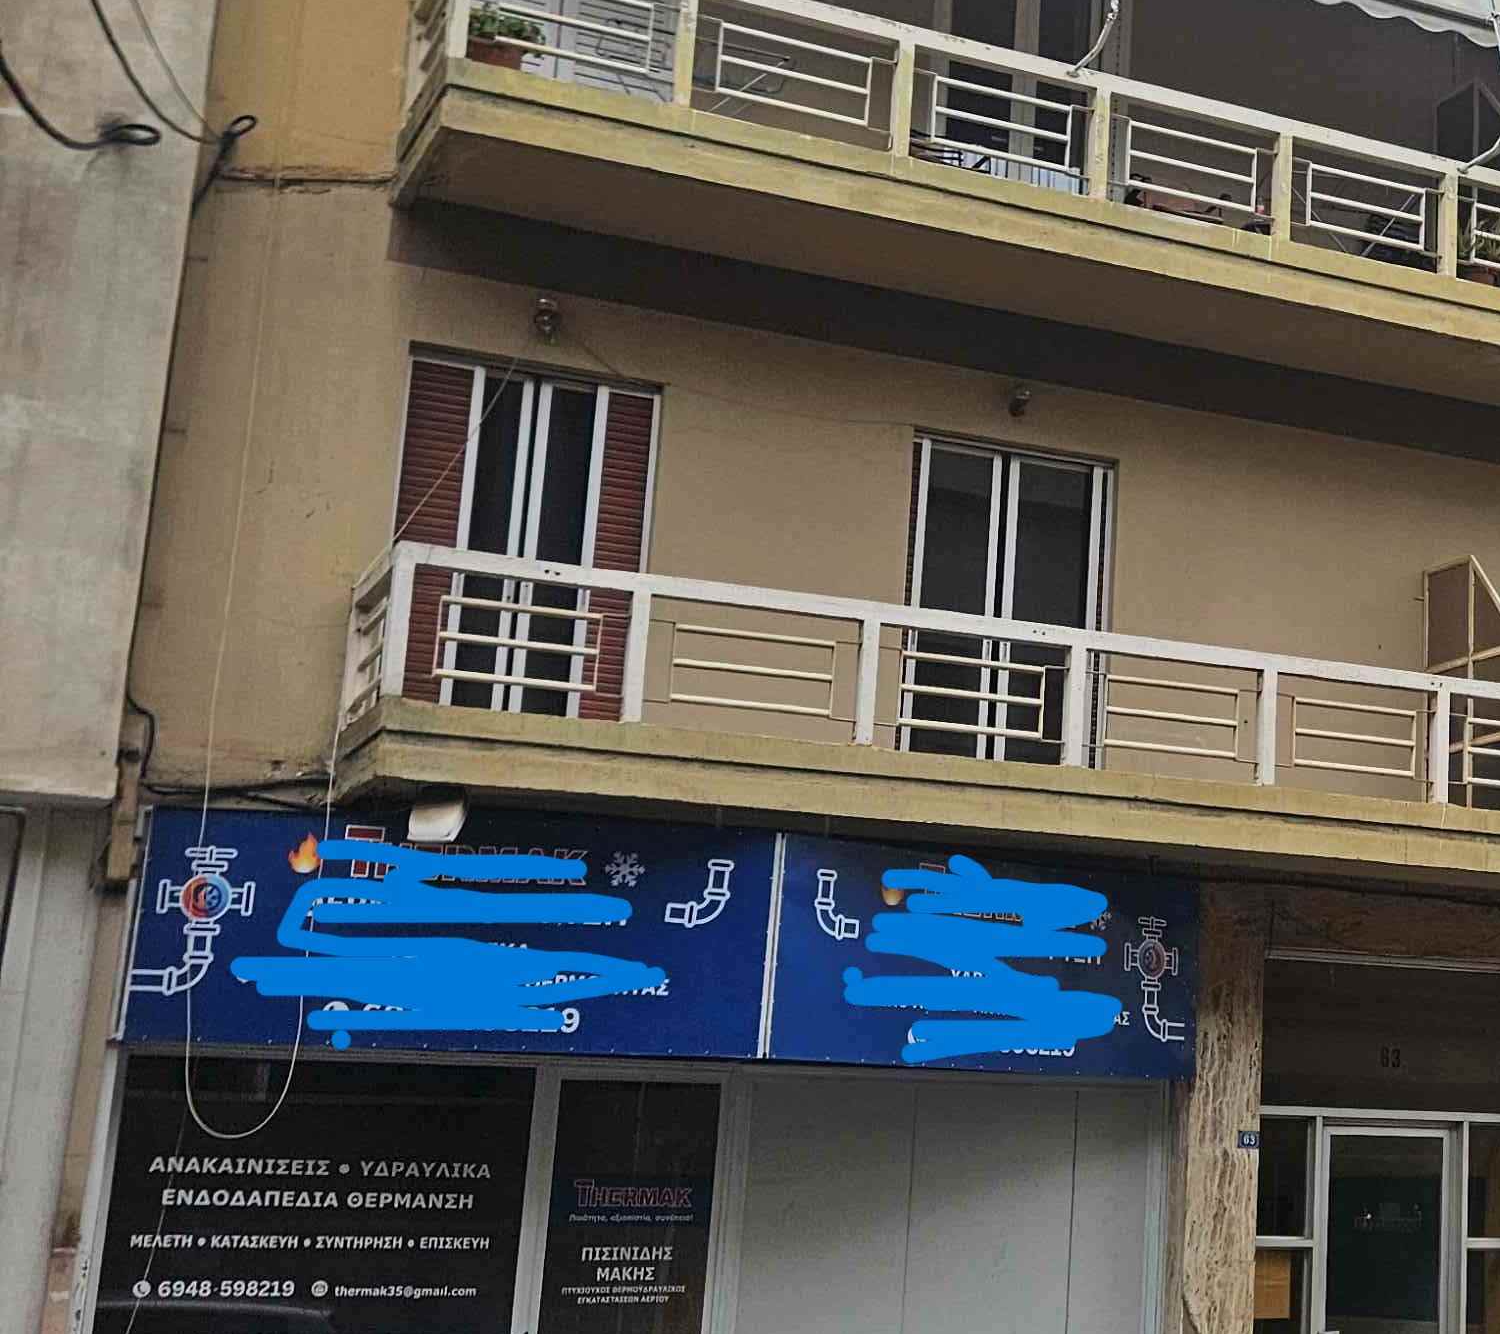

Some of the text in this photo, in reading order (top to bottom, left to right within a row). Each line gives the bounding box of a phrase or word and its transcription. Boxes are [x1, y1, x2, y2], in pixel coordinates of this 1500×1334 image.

[149, 1156, 491, 1179] ΑΝΑΚΑΙΝΙΣΕΙΣ ΥΔΡΑΥΛΙΚΑ
[161, 1188, 474, 1210] ΕΝΔΟΔΑΠΕΔΙΑ ΘΕΡΜΑΝΣΗ
[130, 1234, 491, 1250] ΜΕΛΕΤΗ ΚΑΤΑΣΚΕΥΗ ΣΥΝΤΗΡΗΣΗ ΕΠΙΣΚΕΥΗ
[581, 1246, 674, 1262] ΠΙΣΙΝΙΔΗΣ
[596, 1267, 656, 1282] ΜΑΚΗΣ
[335, 1285, 478, 1300] thermak35@gmail.com
